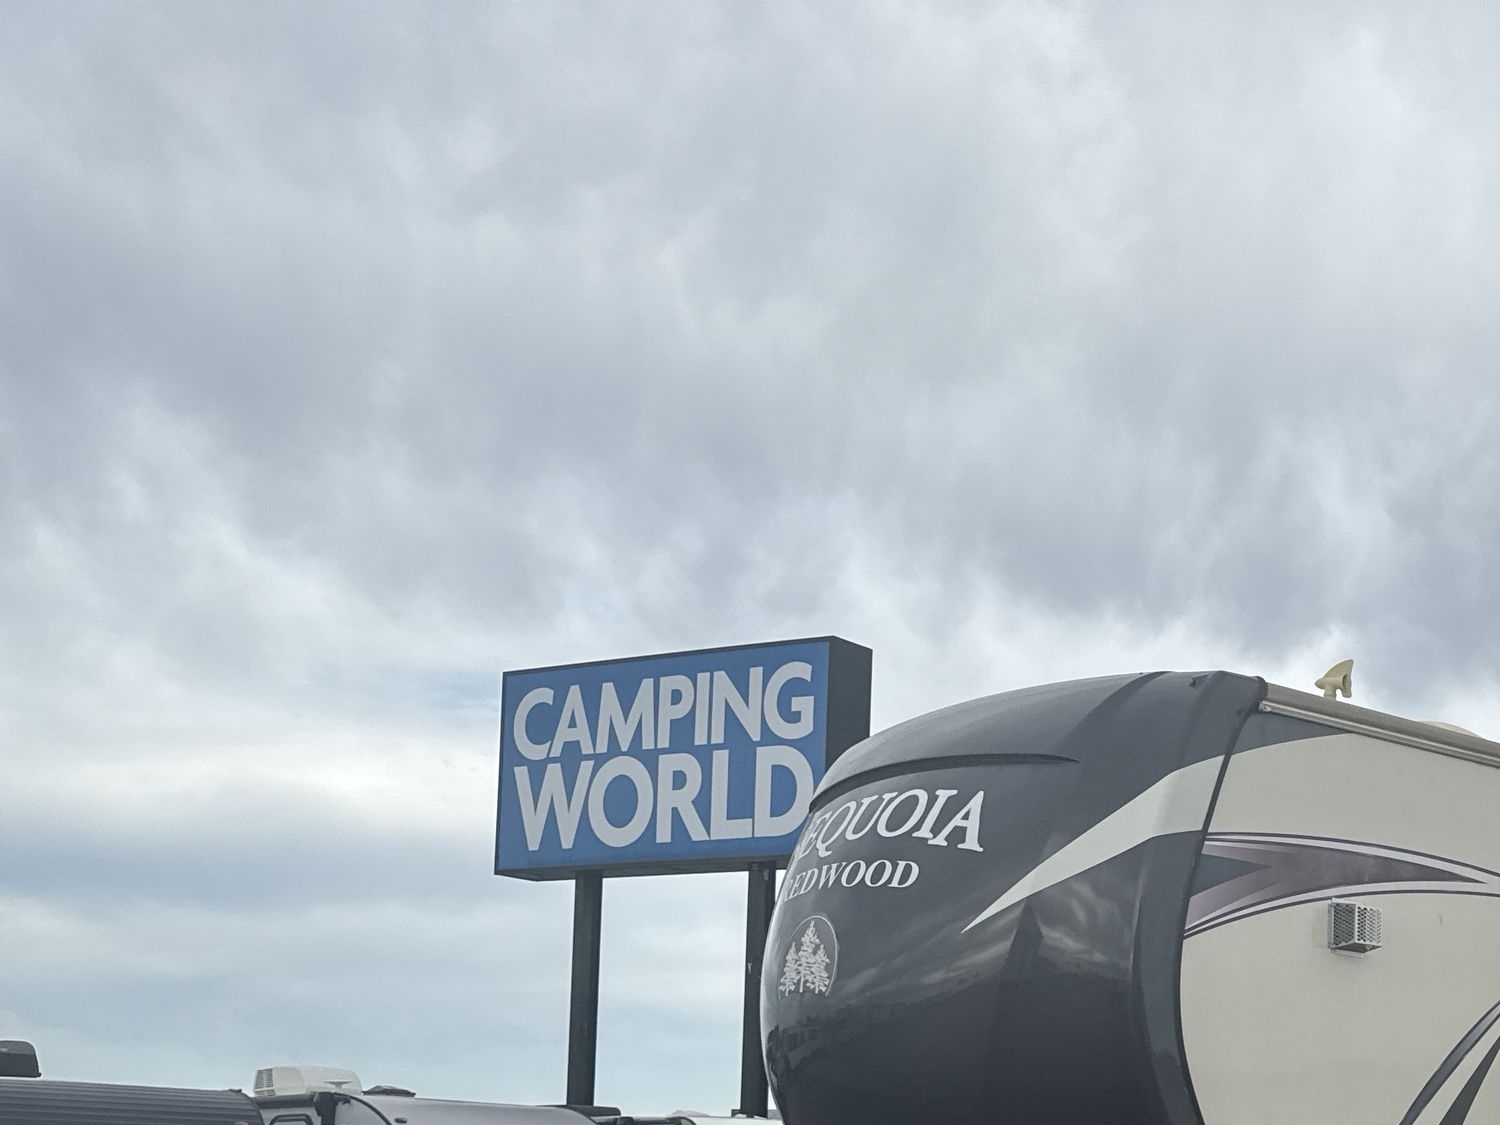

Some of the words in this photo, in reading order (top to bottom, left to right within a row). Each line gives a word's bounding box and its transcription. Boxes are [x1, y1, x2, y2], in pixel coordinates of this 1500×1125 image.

[512, 660, 815, 761] CAMPING
[513, 745, 815, 851] WORLD
[795, 788, 985, 860] EQUOIA
